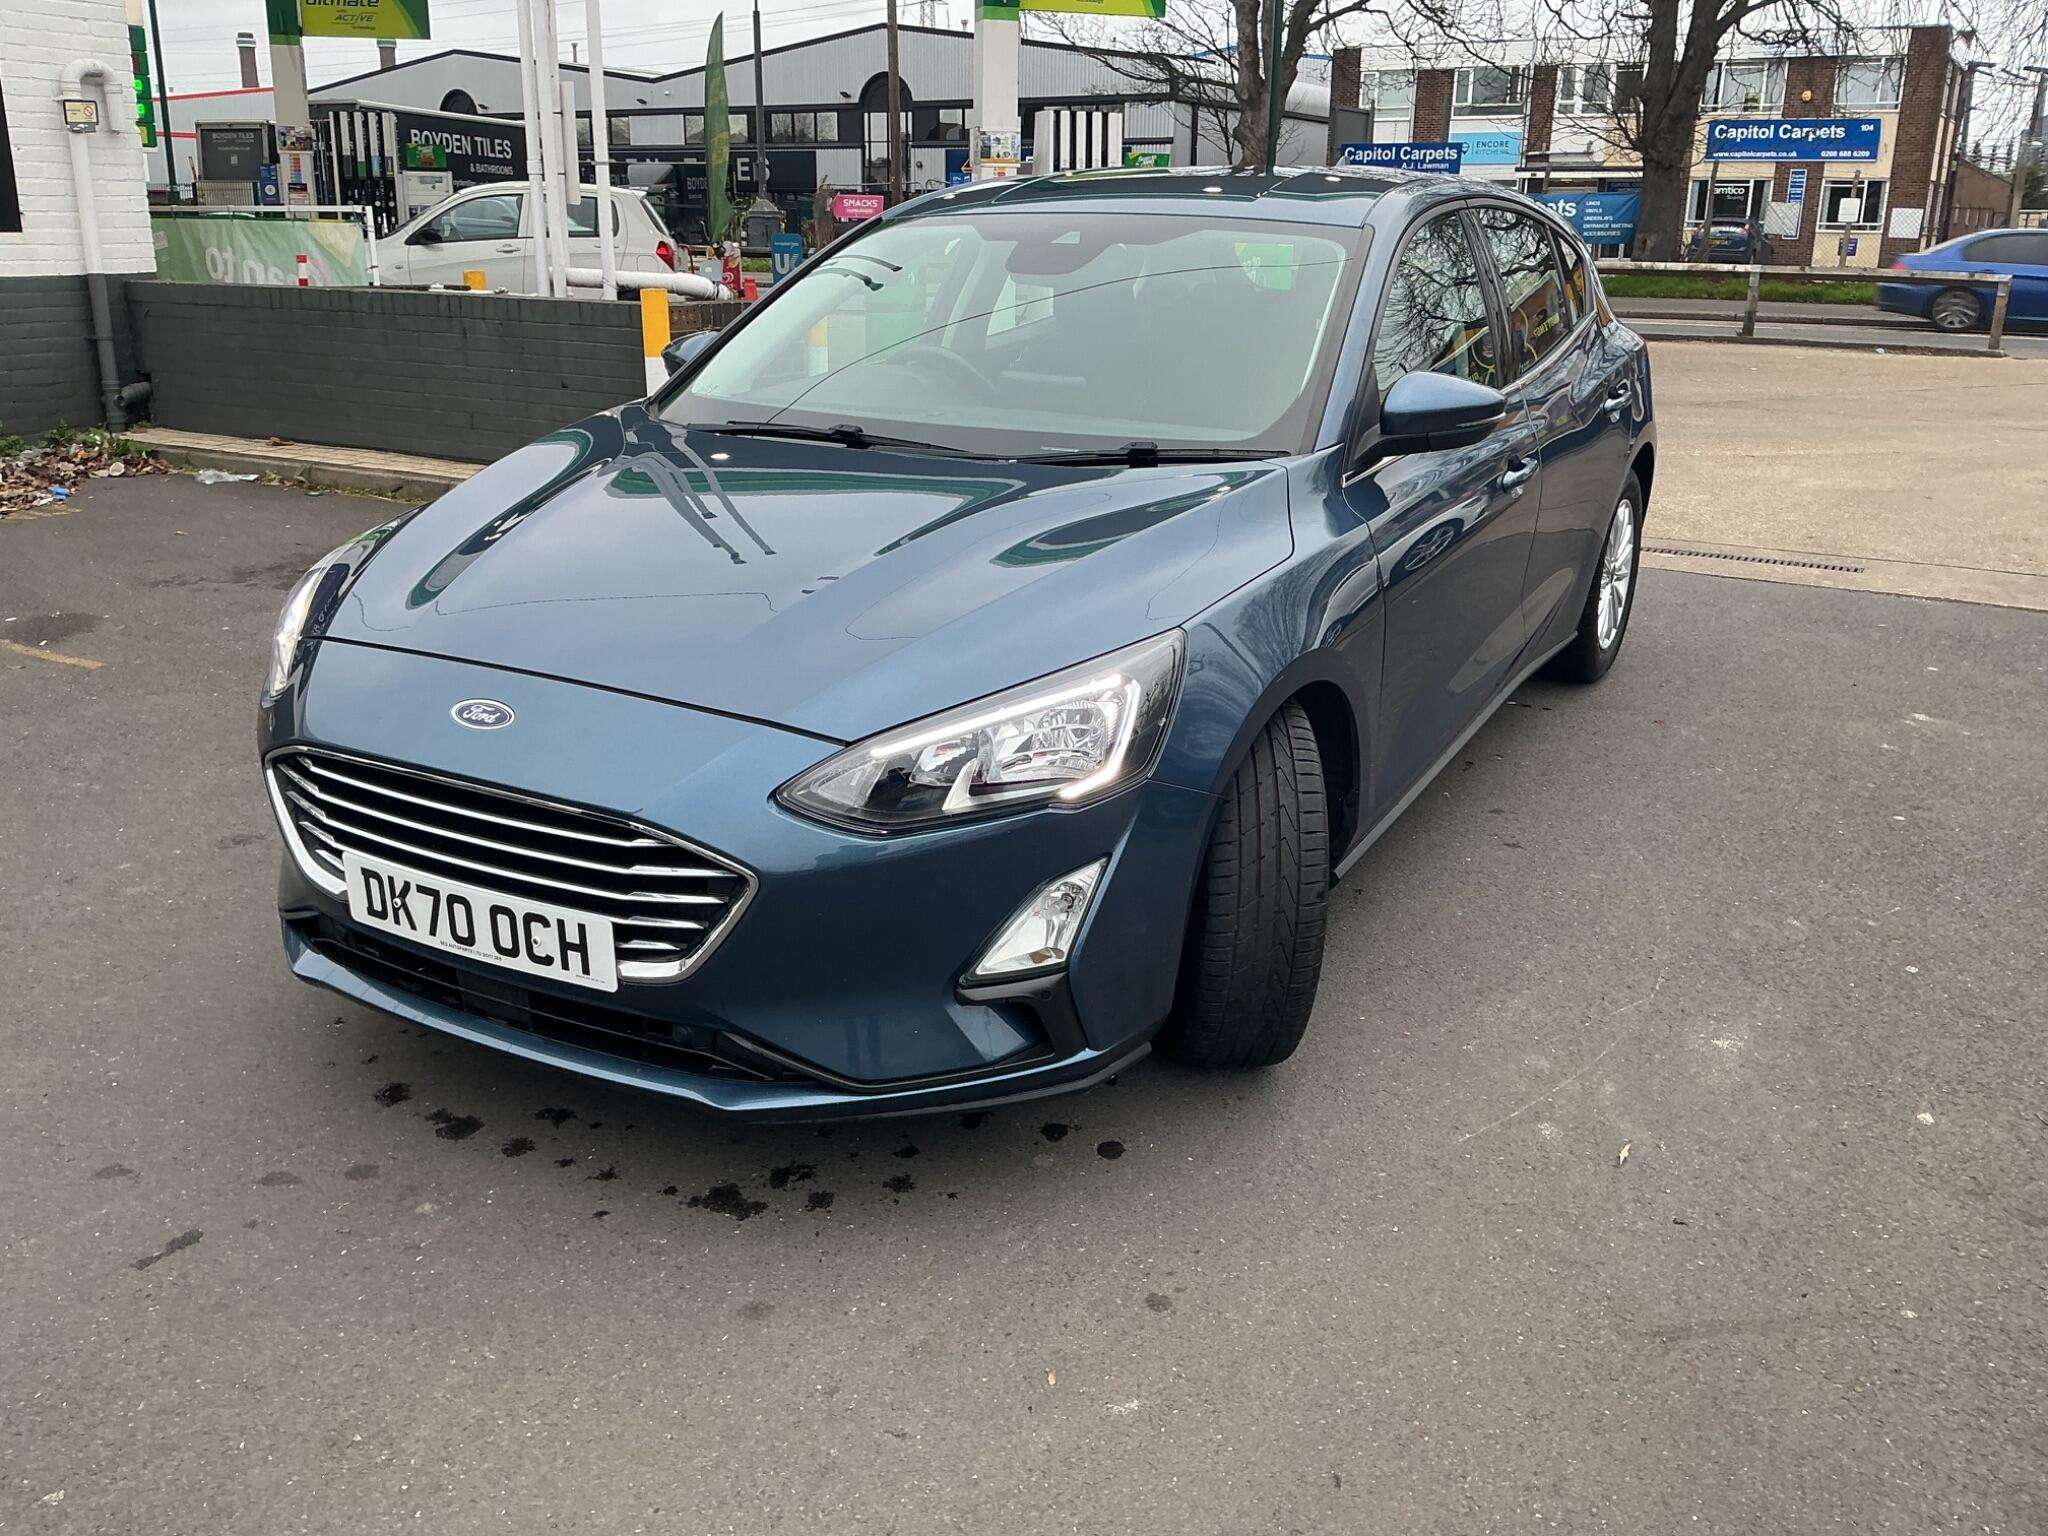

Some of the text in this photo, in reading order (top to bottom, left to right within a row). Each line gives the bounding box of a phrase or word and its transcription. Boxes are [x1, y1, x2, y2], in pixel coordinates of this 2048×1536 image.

[334, 14, 374, 22] ACTIVE
[1714, 124, 1846, 142] Capitol Carpets
[1860, 124, 1874, 132] 104
[474, 136, 513, 159] TILES
[1344, 146, 1458, 163] Capitol Carpets
[475, 163, 514, 175] BATHROOMS
[843, 199, 878, 208] SMACKS
[462, 704, 501, 723] Ford
[360, 866, 591, 976] DK70 OCH
